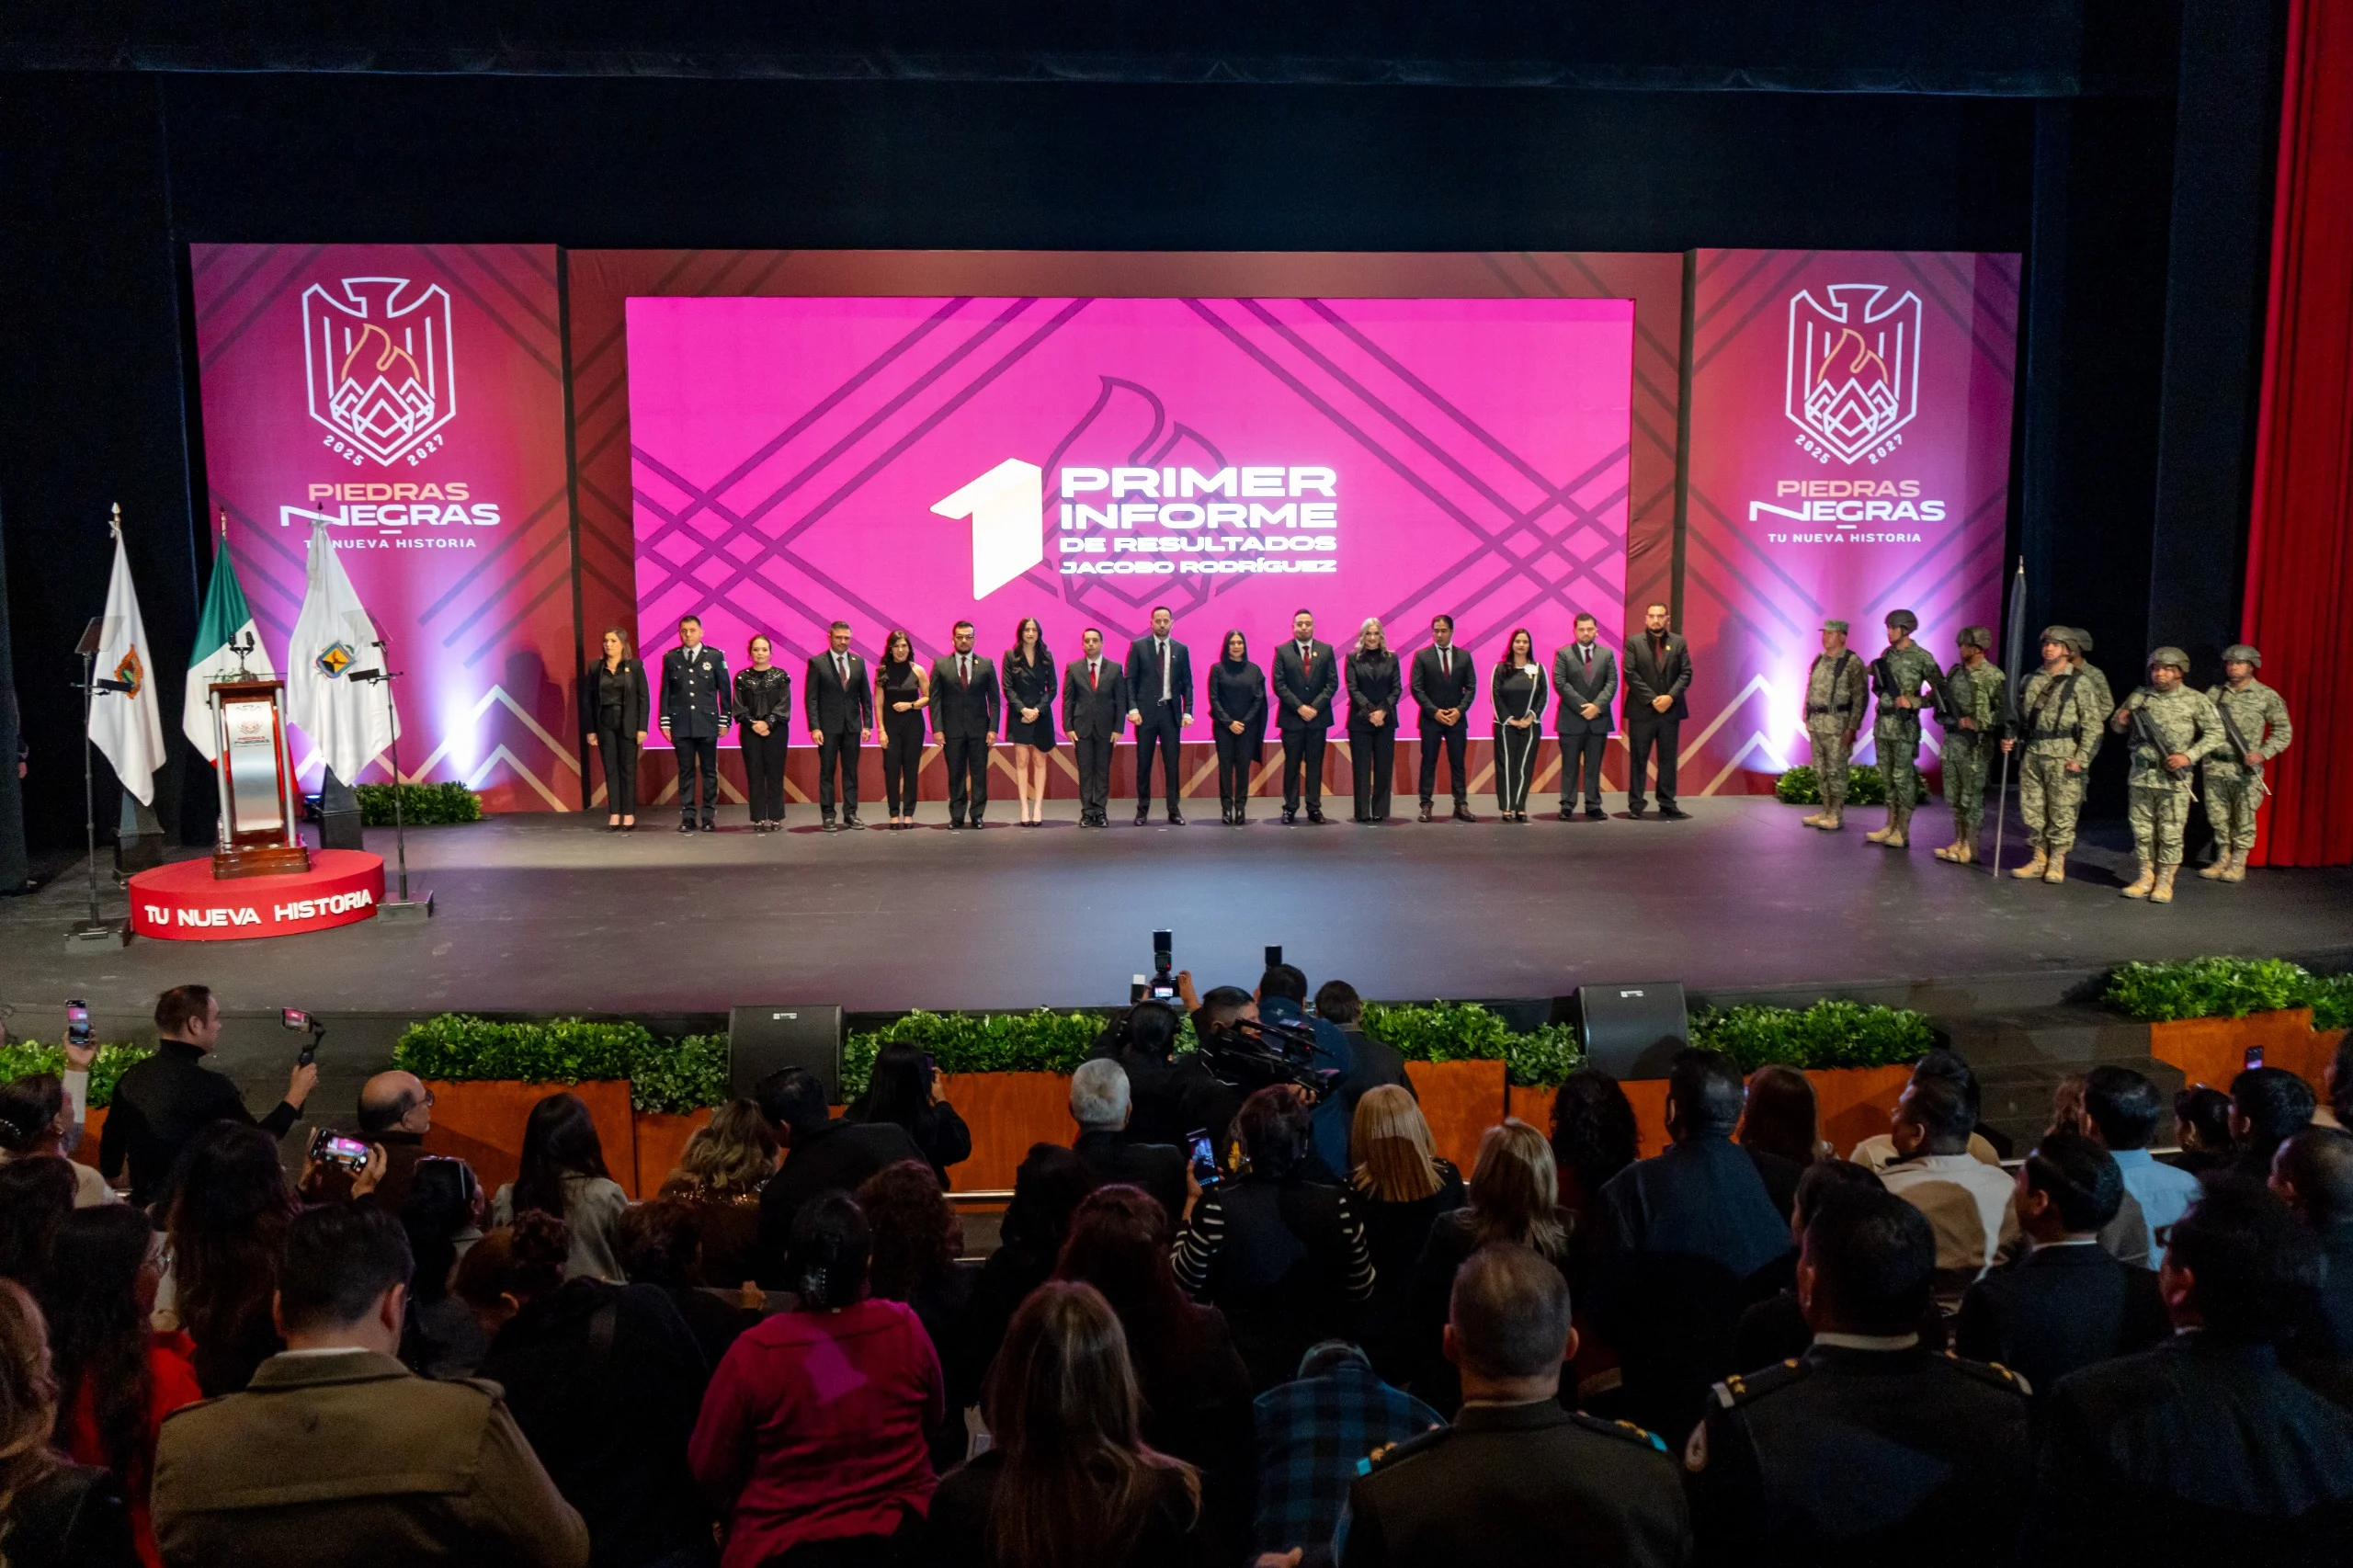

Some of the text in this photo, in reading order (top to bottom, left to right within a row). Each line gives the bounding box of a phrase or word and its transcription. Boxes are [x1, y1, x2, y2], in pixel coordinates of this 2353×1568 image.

[323, 435, 364, 466] 2025
[406, 434, 444, 466] 2027
[1794, 434, 1830, 464] 2025
[1868, 433, 1903, 464] 2027
[308, 482, 470, 501] PIEDRAS
[1060, 466, 1337, 498] PRIMER
[1777, 479, 1920, 497] PIEDRAS
[279, 503, 501, 527] NEGRAS
[1060, 502, 1337, 529] INFORME
[1749, 500, 1946, 521] NEGRAS
[332, 539, 390, 549] NUEVA
[395, 538, 476, 549] HISTORIA
[1060, 536, 1337, 552] DE RESULTADOS
[1768, 532, 1922, 543] TU NUEVA HISTORIA
[1059, 557, 1337, 574] JACOBO RODRÍGUEZ
[144, 889, 372, 927] TU NUEVA HISTORIA
